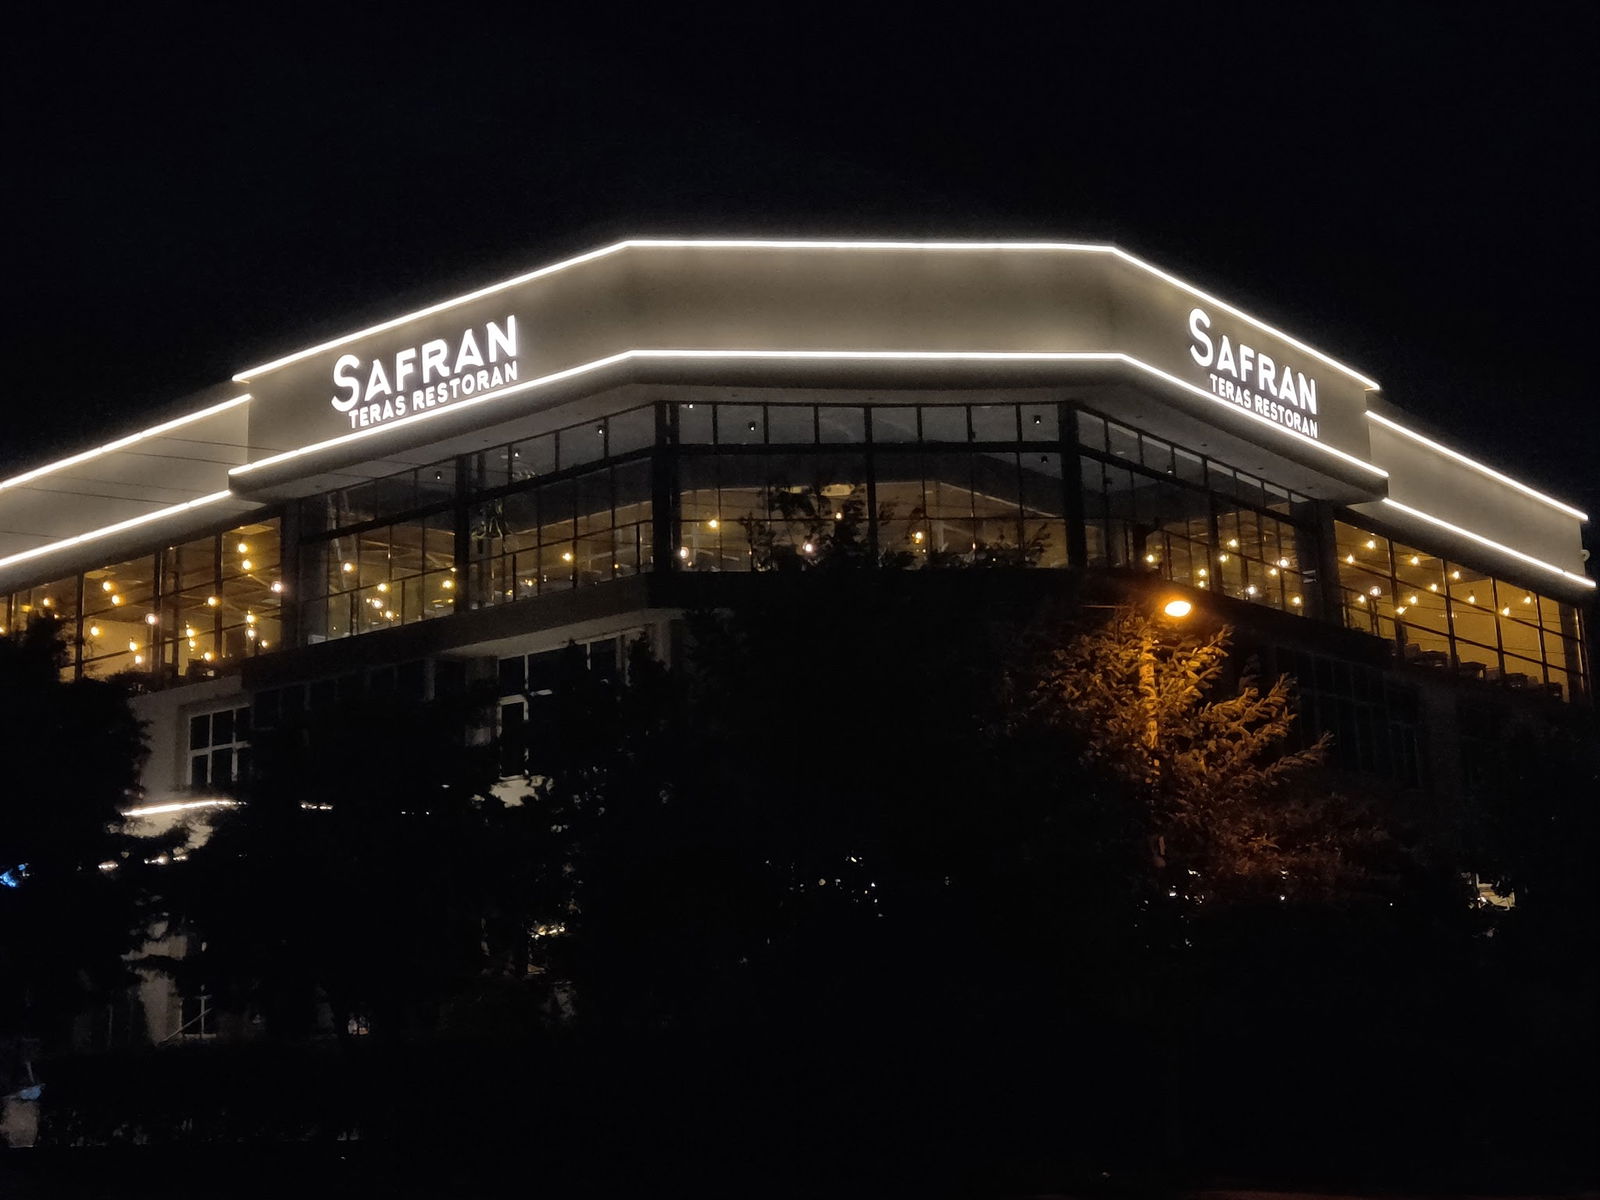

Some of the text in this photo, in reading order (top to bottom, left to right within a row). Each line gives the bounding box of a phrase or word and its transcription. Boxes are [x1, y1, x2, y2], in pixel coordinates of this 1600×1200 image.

[331, 314, 517, 412] SAFRAN
[349, 361, 518, 428] TERAS RESTORAN
[1189, 308, 1317, 415] SAFRAN
[1210, 373, 1318, 438] TERAS RESTORAN
